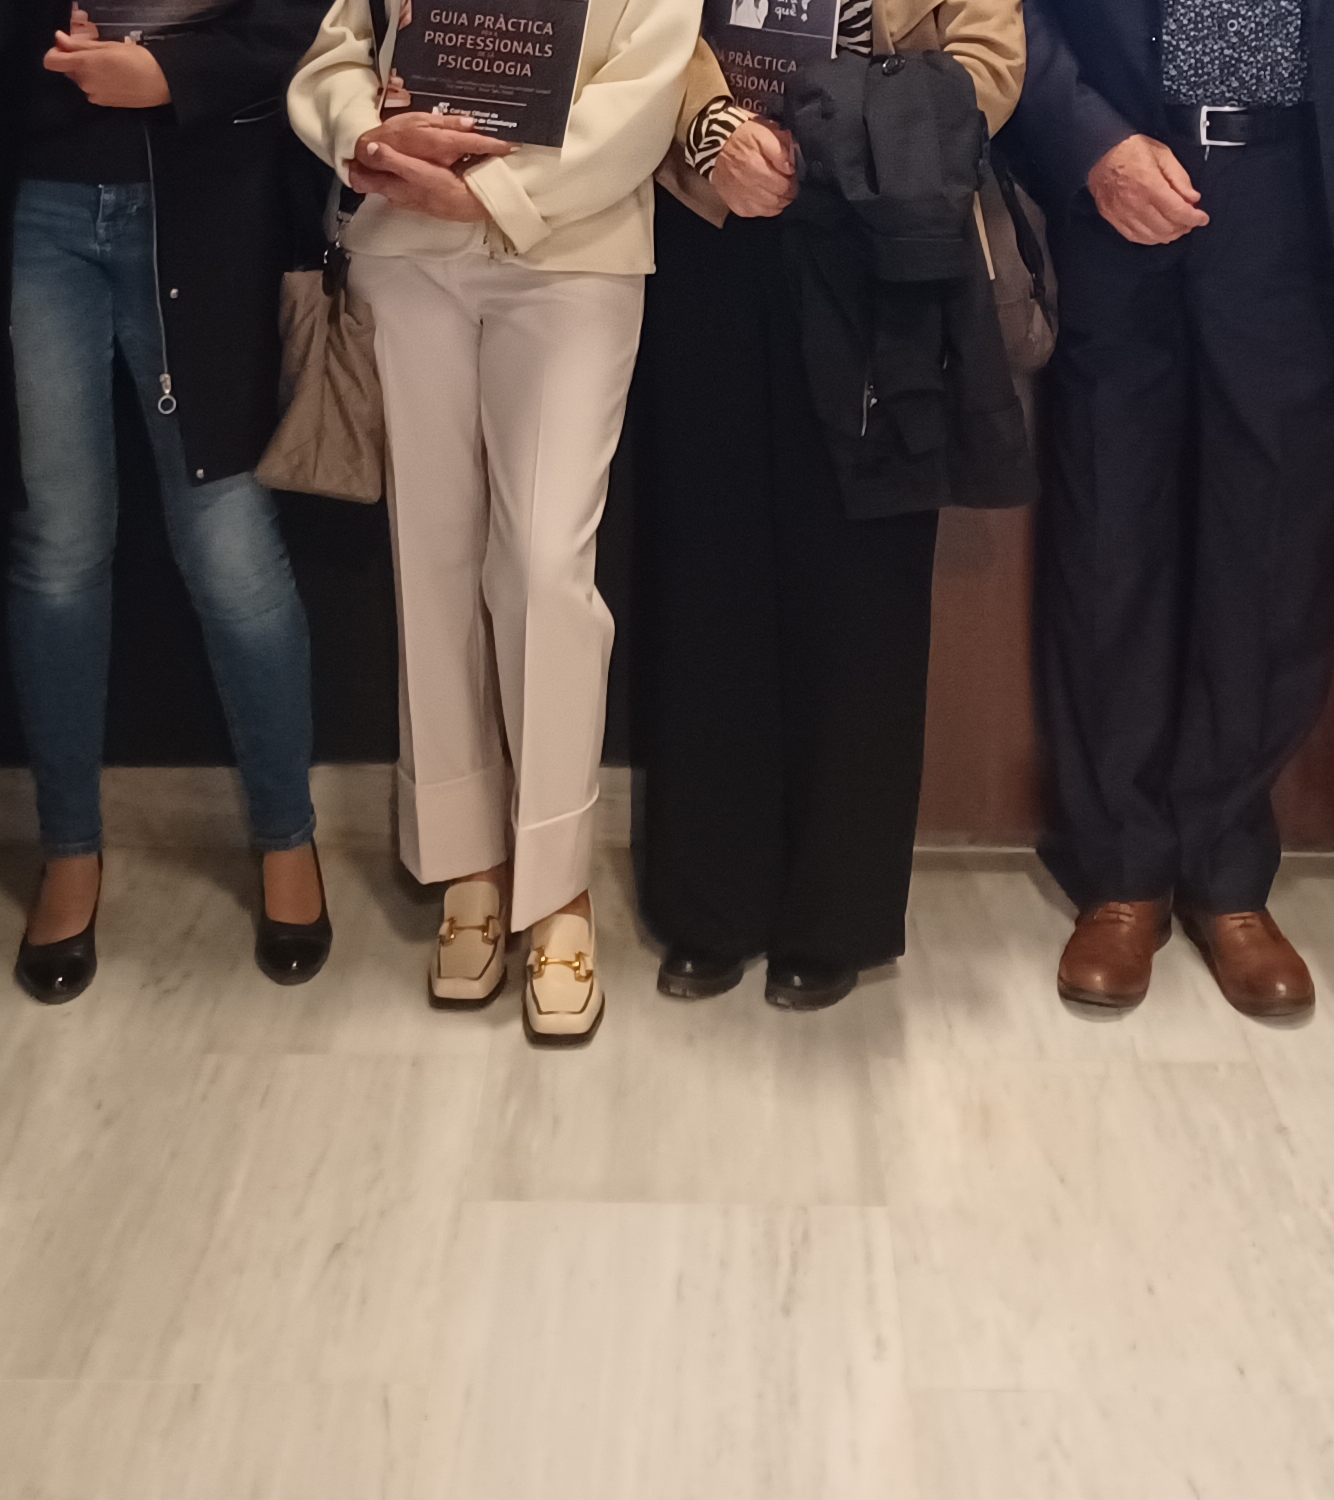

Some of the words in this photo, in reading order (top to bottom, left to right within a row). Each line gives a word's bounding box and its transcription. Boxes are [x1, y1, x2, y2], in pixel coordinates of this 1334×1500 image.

[430, 9, 468, 26] GUIA
[474, 14, 554, 36] PRÀCTICA
[424, 30, 553, 58] PROFESSIONALS
[437, 54, 532, 77] PSICOLOGIA
[728, 51, 797, 73] PRÀCTICA
